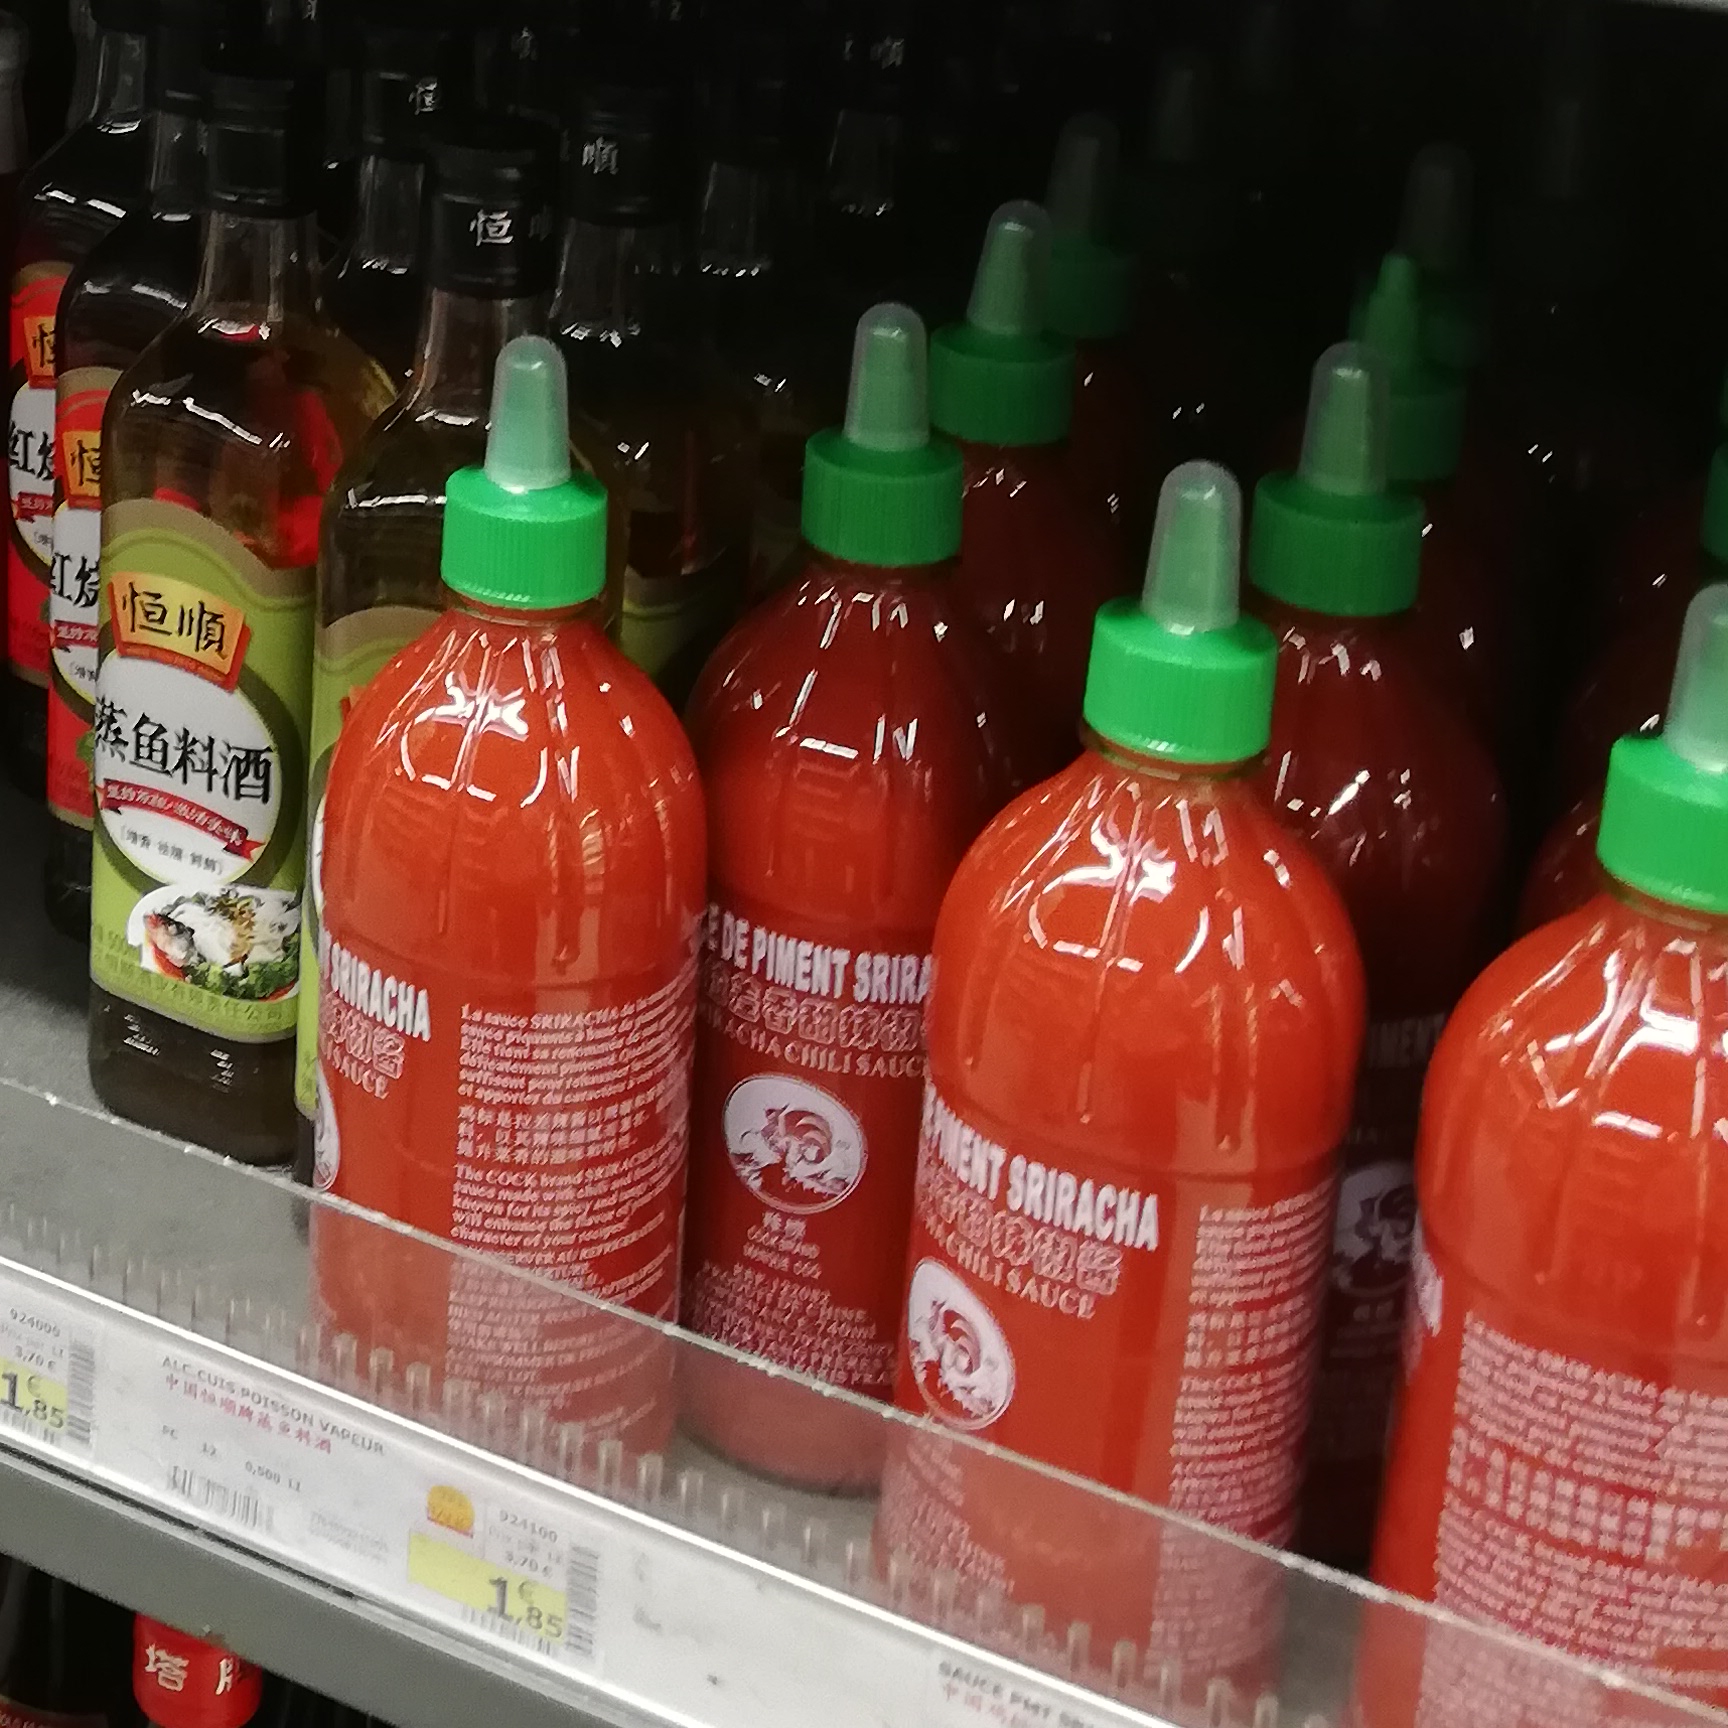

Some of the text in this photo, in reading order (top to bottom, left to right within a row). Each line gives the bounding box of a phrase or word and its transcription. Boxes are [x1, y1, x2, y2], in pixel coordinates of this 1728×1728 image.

[330, 942, 431, 1042] SRIRACHA
[751, 924, 851, 1000] PIMENT
[1006, 1153, 1159, 1252] SRIRACHA
